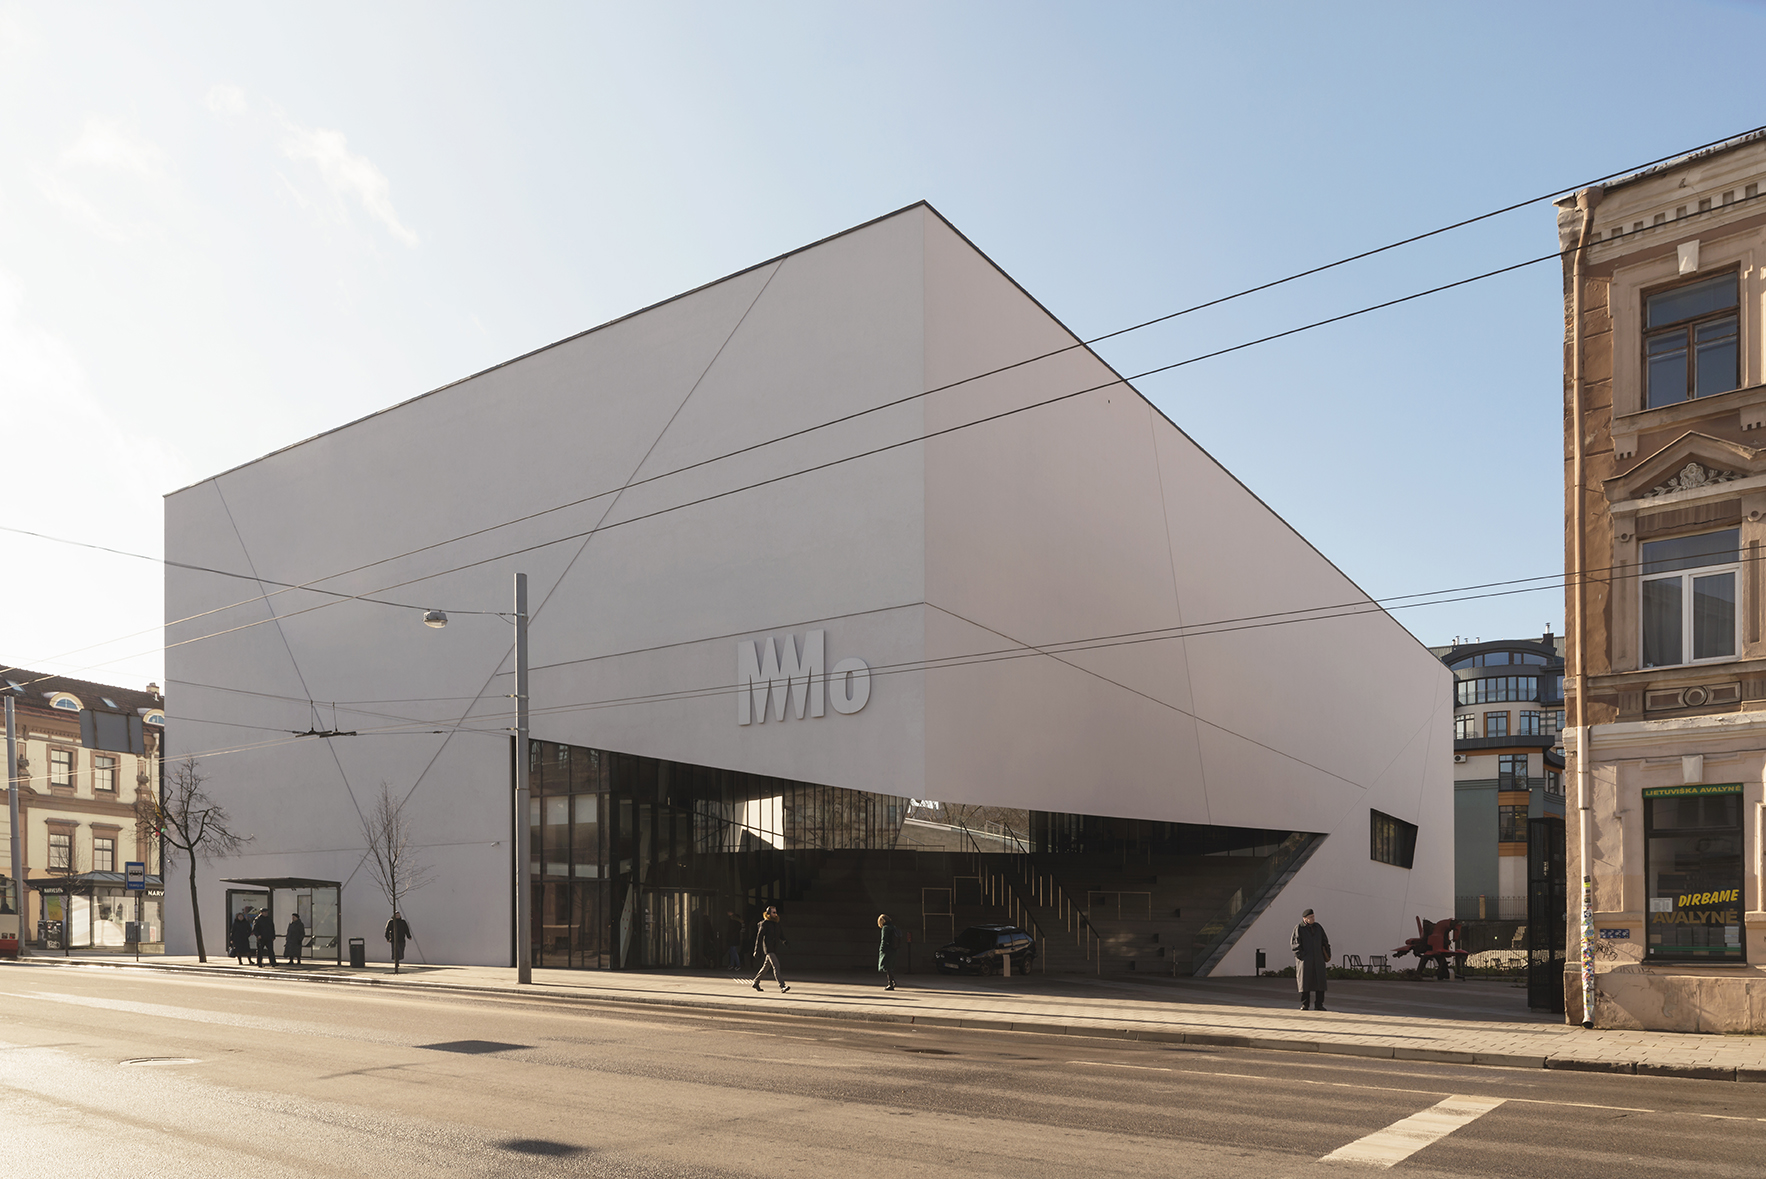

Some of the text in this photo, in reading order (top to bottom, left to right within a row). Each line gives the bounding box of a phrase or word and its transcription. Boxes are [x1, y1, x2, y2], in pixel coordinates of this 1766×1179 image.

[1645, 784, 1742, 795] LIETUVIŠKA AVALYNĖ
[1678, 889, 1740, 907] DIRBAME
[1652, 909, 1738, 924] AVALYNĖ
